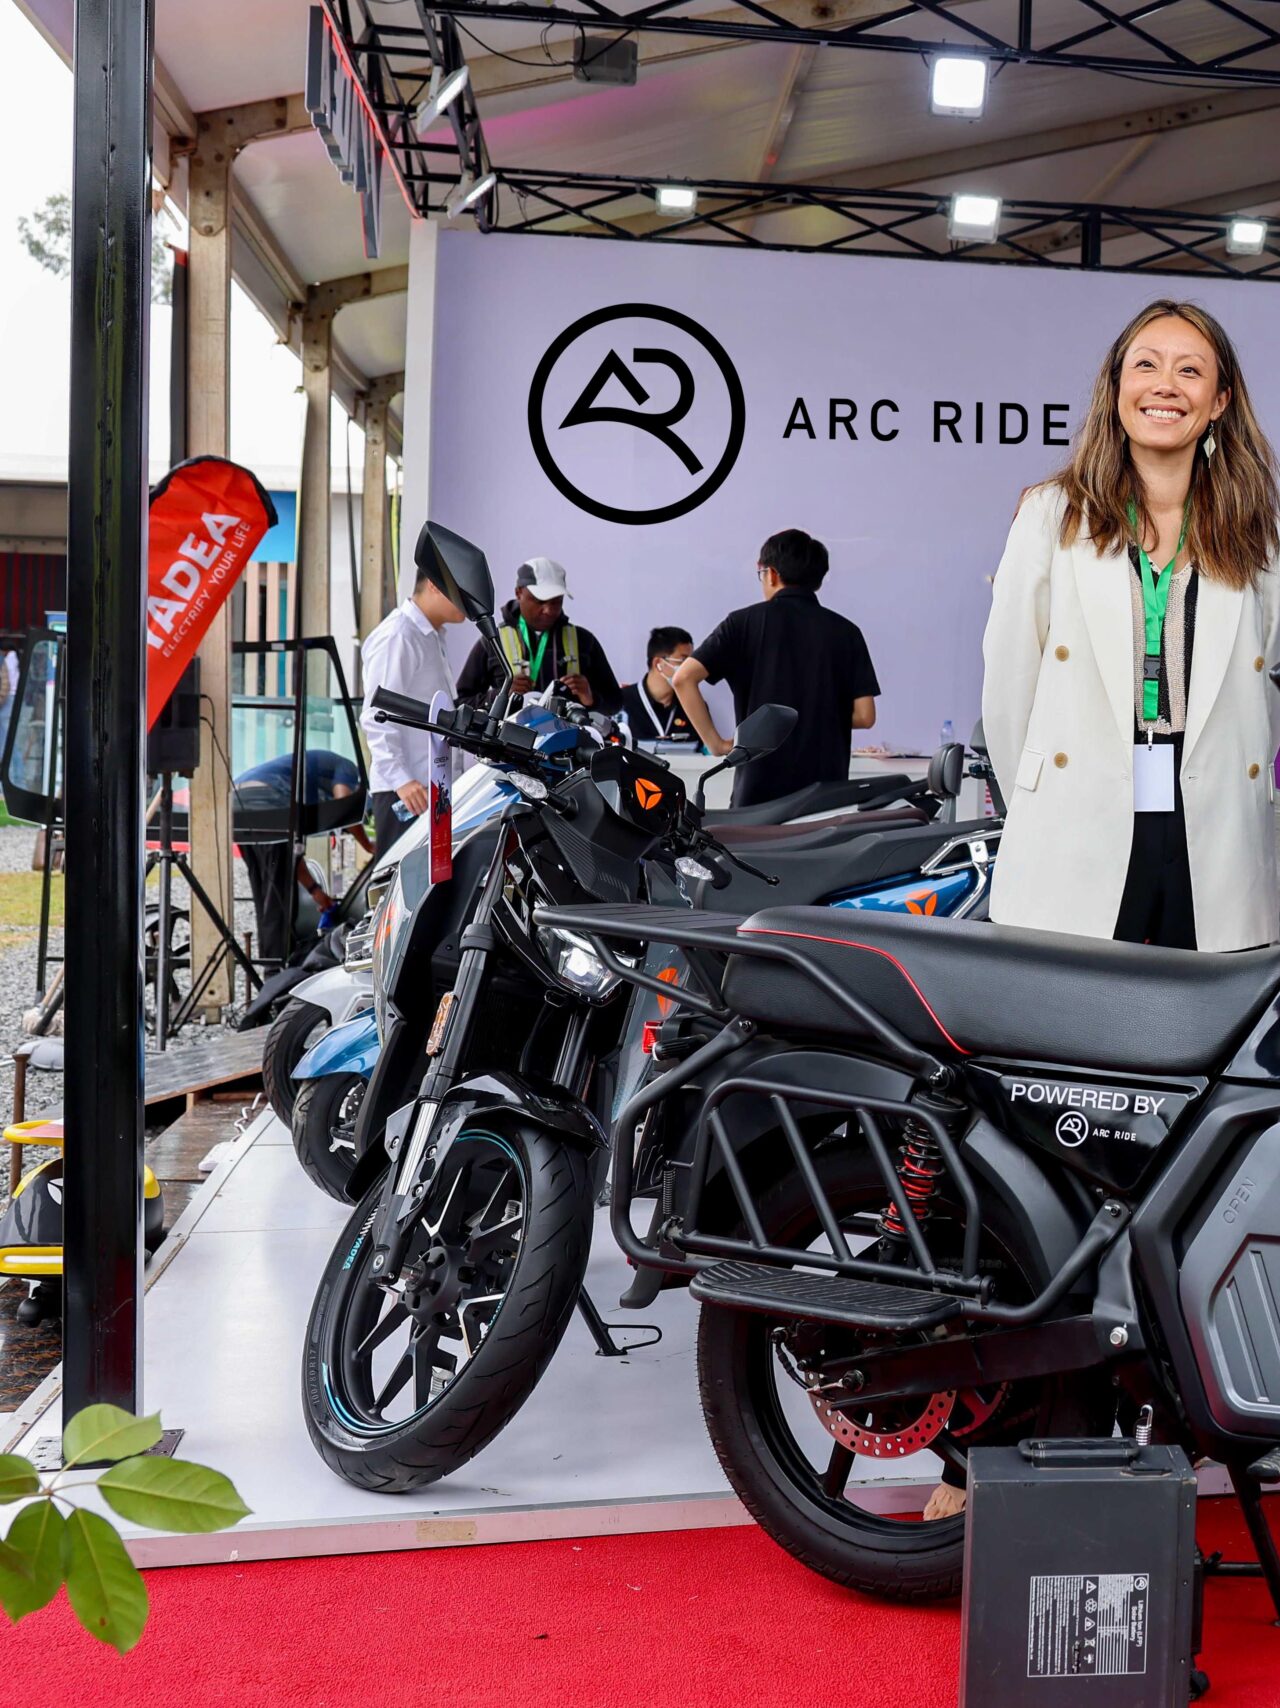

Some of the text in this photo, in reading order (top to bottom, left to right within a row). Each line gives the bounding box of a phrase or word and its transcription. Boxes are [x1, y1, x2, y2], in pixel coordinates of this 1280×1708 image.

[782, 396, 1071, 447] ARC RIDE
[162, 521, 251, 658] ELECTRIFY YOUR LIFE
[1010, 1083, 1166, 1116] POWERED BY
[1092, 1127, 1137, 1142] ARC RIDE
[1223, 1176, 1257, 1225] OPEN
[342, 1235, 366, 1271] YADEA
